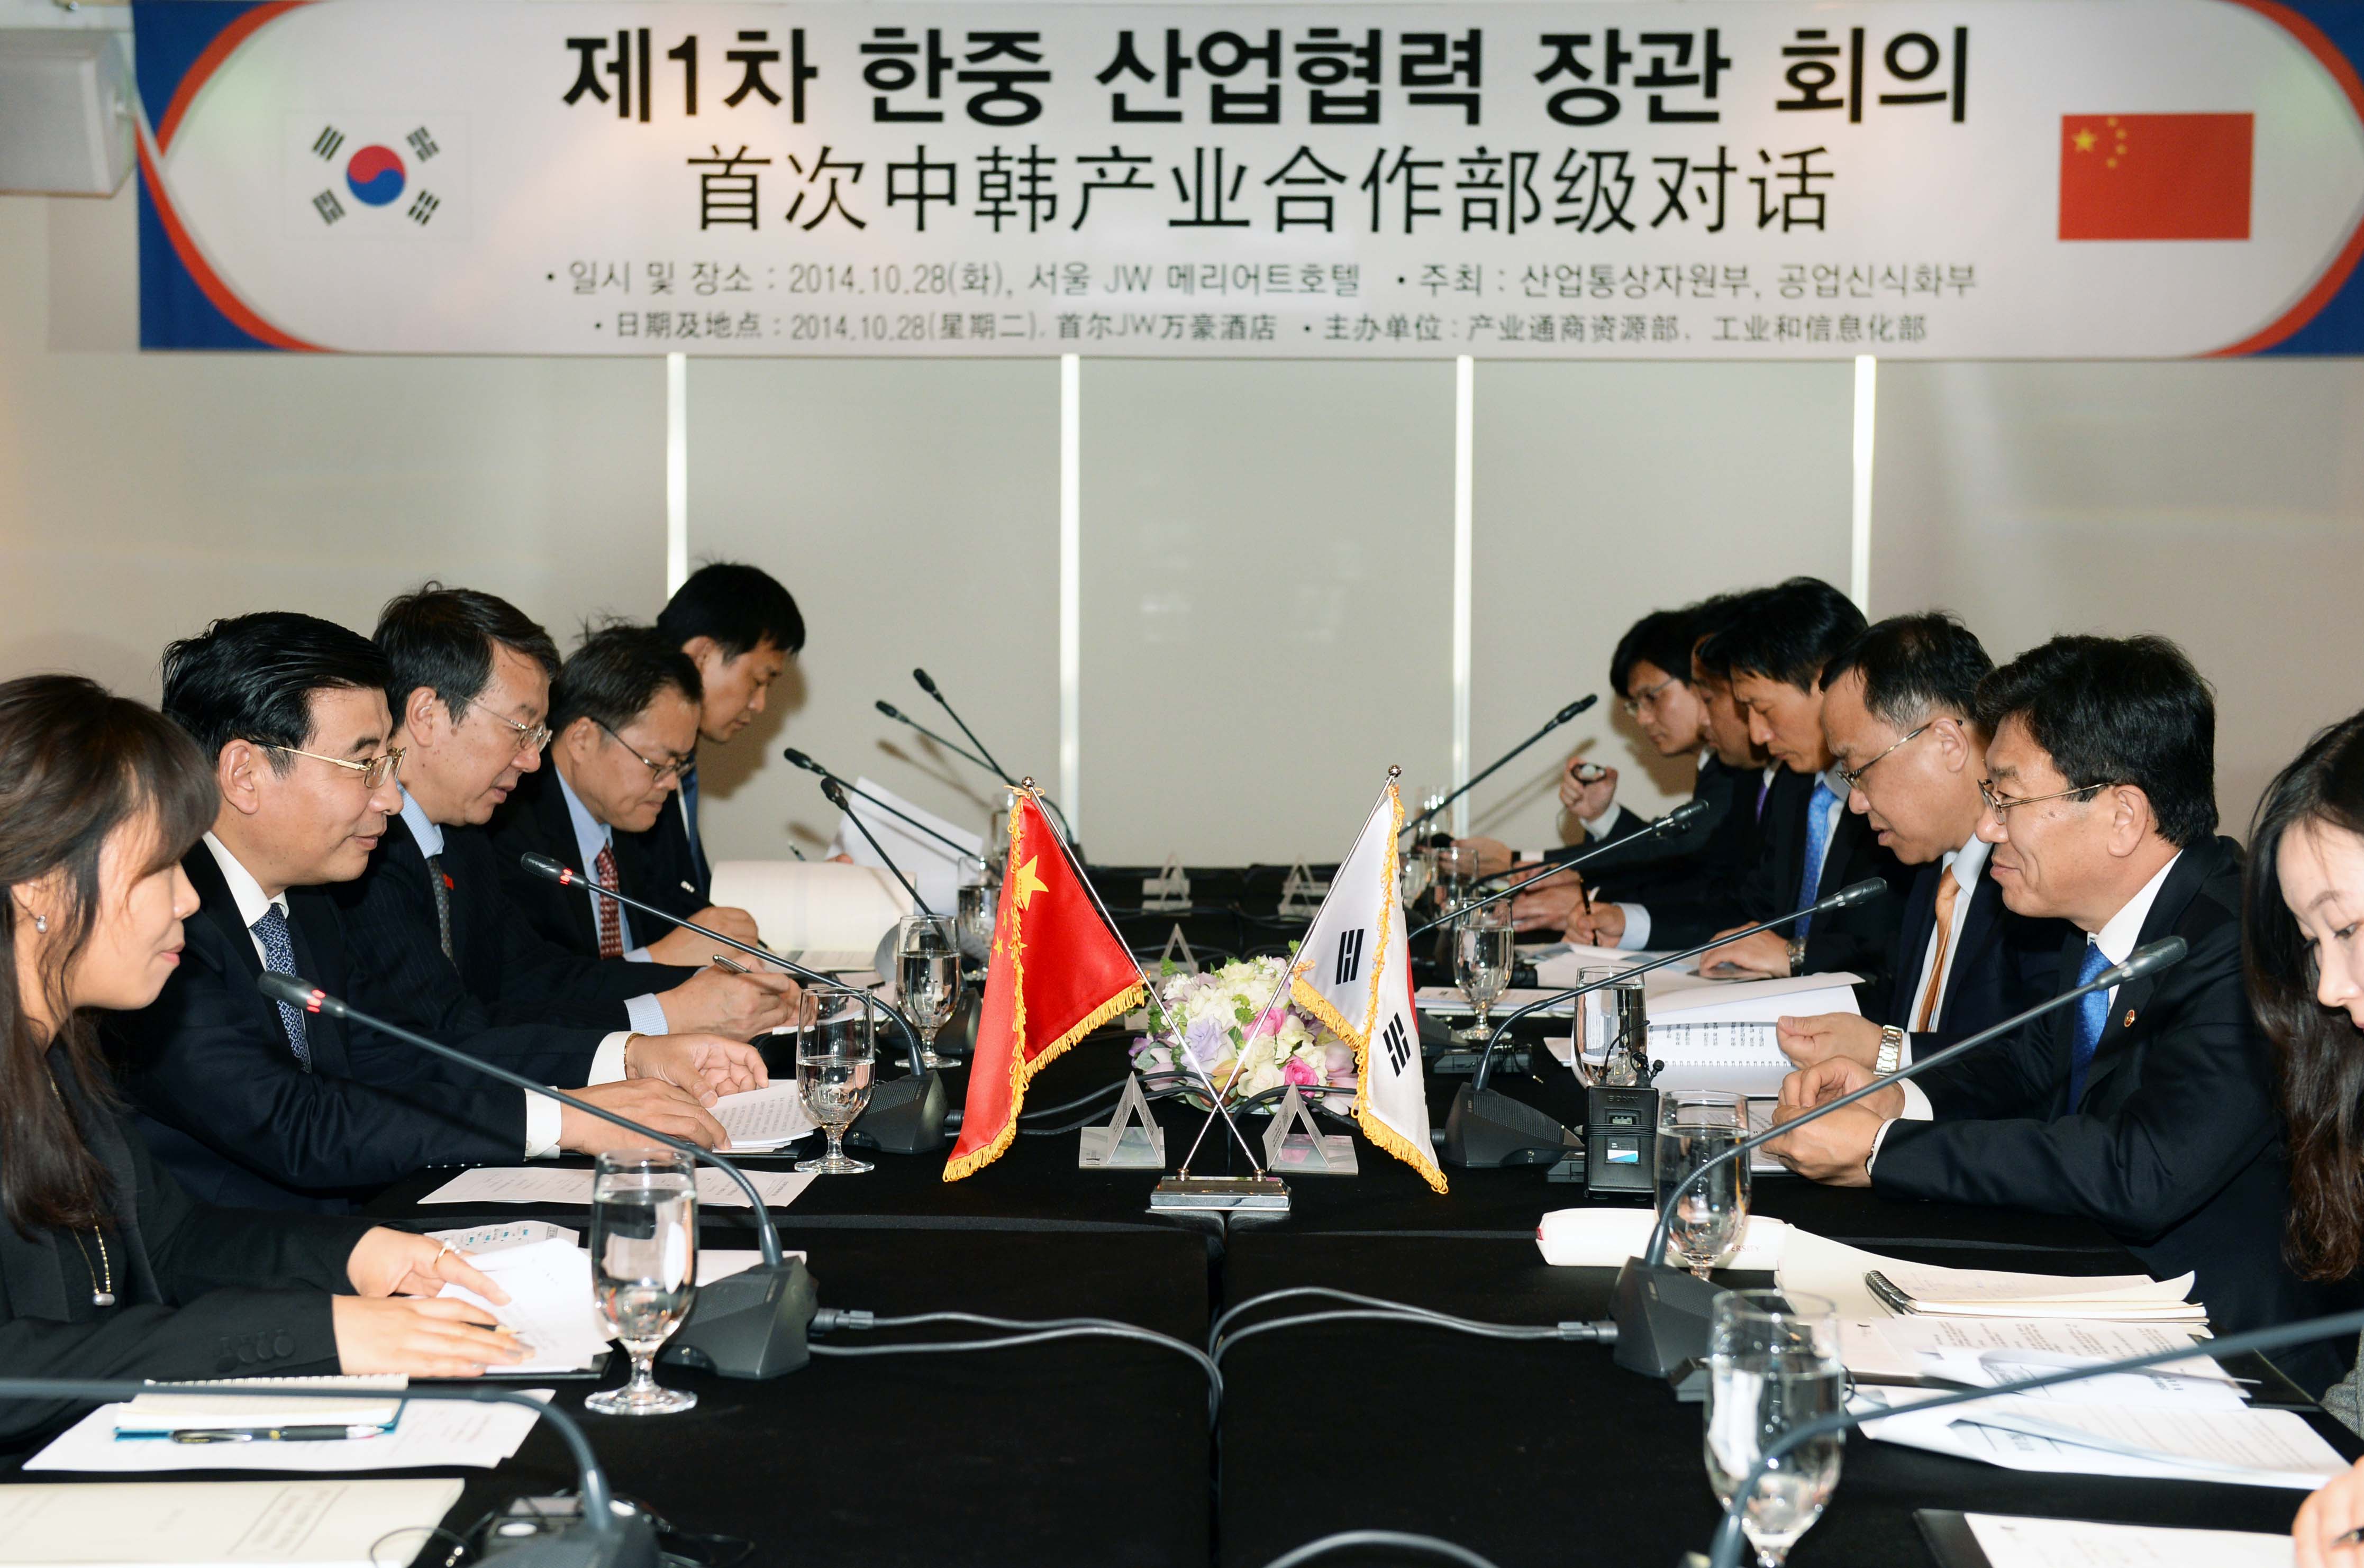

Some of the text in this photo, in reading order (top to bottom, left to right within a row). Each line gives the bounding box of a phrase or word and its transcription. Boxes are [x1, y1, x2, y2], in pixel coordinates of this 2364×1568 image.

[563, 26, 1968, 127] 제1차 한중 산업협력 장관 회의
[688, 144, 1834, 235] 首次中韩产业合作部级对话
[569, 260, 631, 295] 일시
[647, 262, 675, 296] 및
[691, 262, 752, 297] 장소
[1029, 262, 1091, 296] 서울
[1105, 265, 1153, 294] JW
[1167, 263, 1360, 298] 메리어트호텔
[1420, 263, 1483, 298] 주최
[1520, 263, 1761, 300] 산업통상자원부,
[1778, 264, 1976, 300] 공업신식화부
[1057, 312, 1277, 342] 首尔JW万豪酒店
[1713, 314, 1927, 343] 工业和信息化部
[1607, 1095, 1639, 1104] SONY
